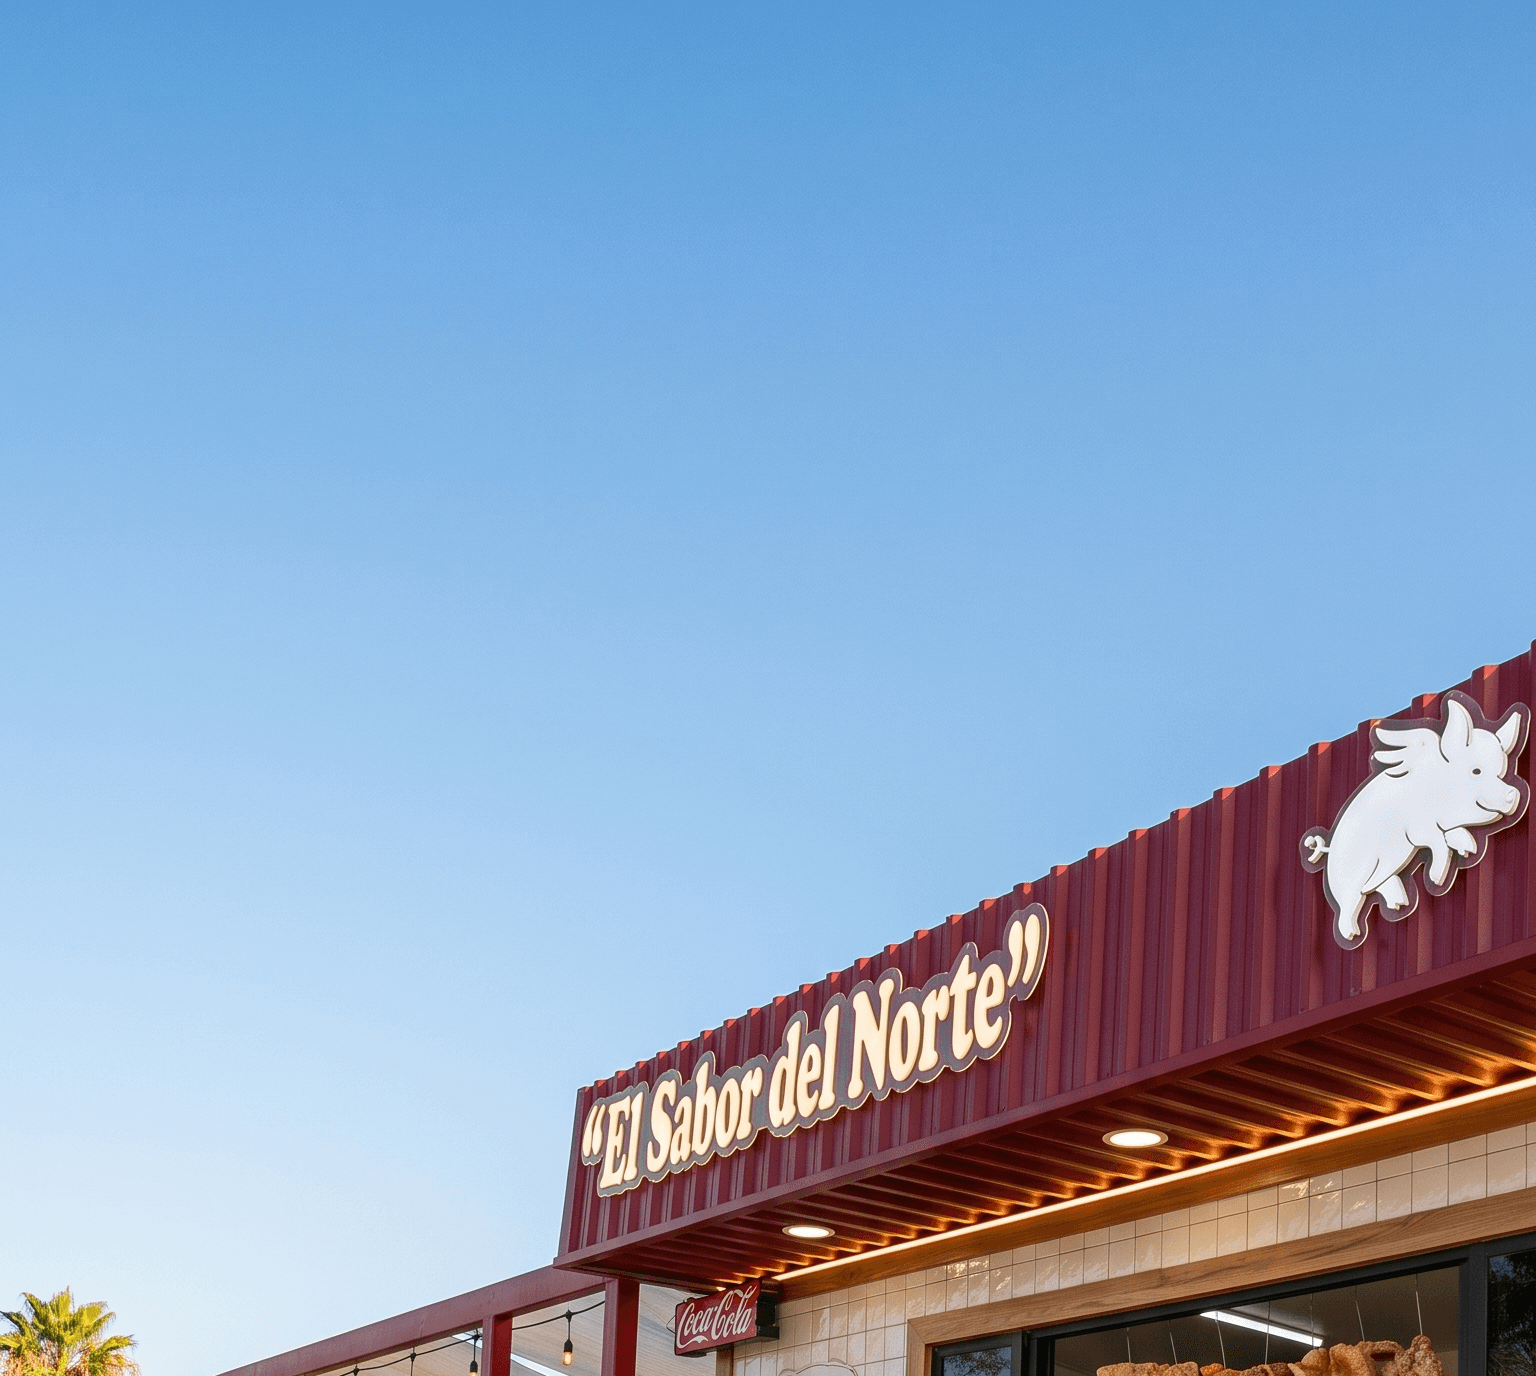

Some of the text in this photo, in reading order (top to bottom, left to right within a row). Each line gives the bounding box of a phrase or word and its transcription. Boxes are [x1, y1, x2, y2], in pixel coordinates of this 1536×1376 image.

[646, 1061, 763, 1174] Sabor
[767, 1003, 841, 1129] del
[677, 1285, 757, 1348] Coca-Cola
